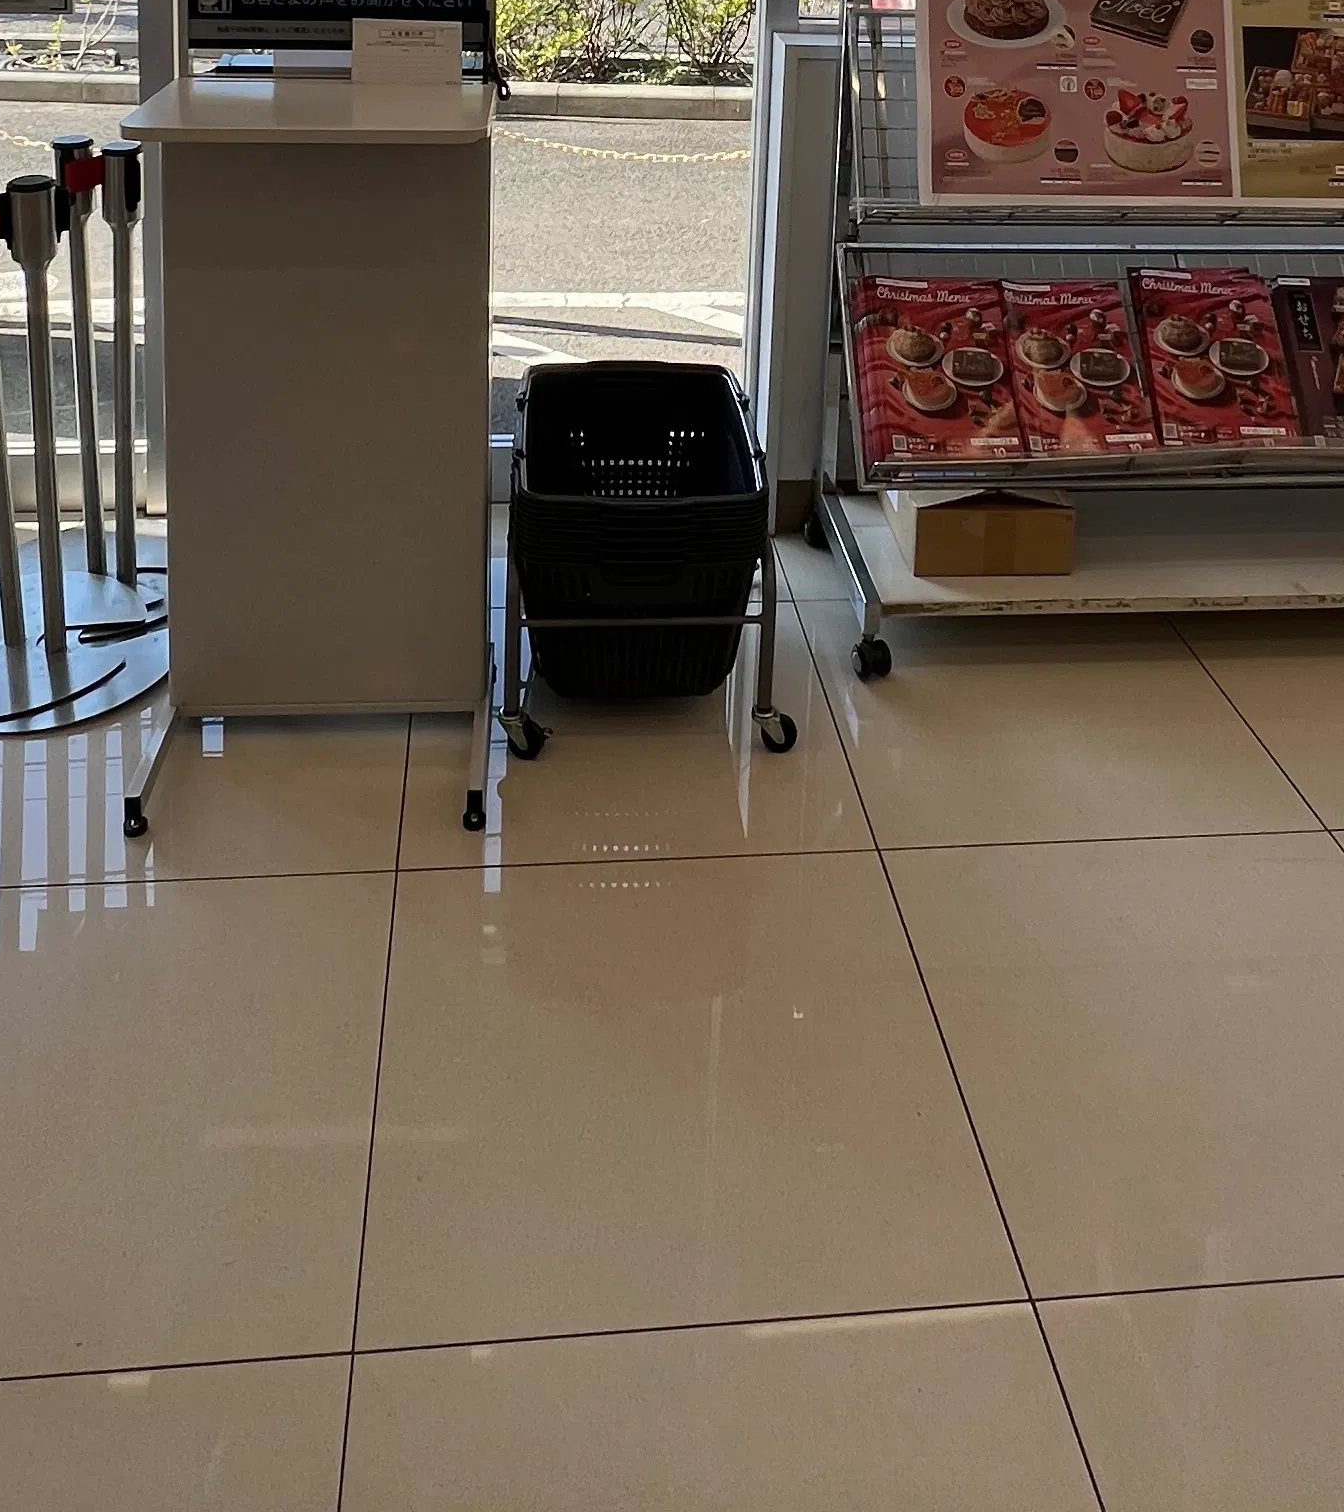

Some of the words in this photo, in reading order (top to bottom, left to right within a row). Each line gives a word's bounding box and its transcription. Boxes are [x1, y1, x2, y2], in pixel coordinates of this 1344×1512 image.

[876, 286, 934, 303] Christmas
[936, 289, 971, 303] Menu
[1141, 277, 1197, 293] Christmas
[1199, 282, 1233, 296] Menu
[1004, 290, 1057, 305] Christmas
[1296, 300, 1313, 341] おせち
